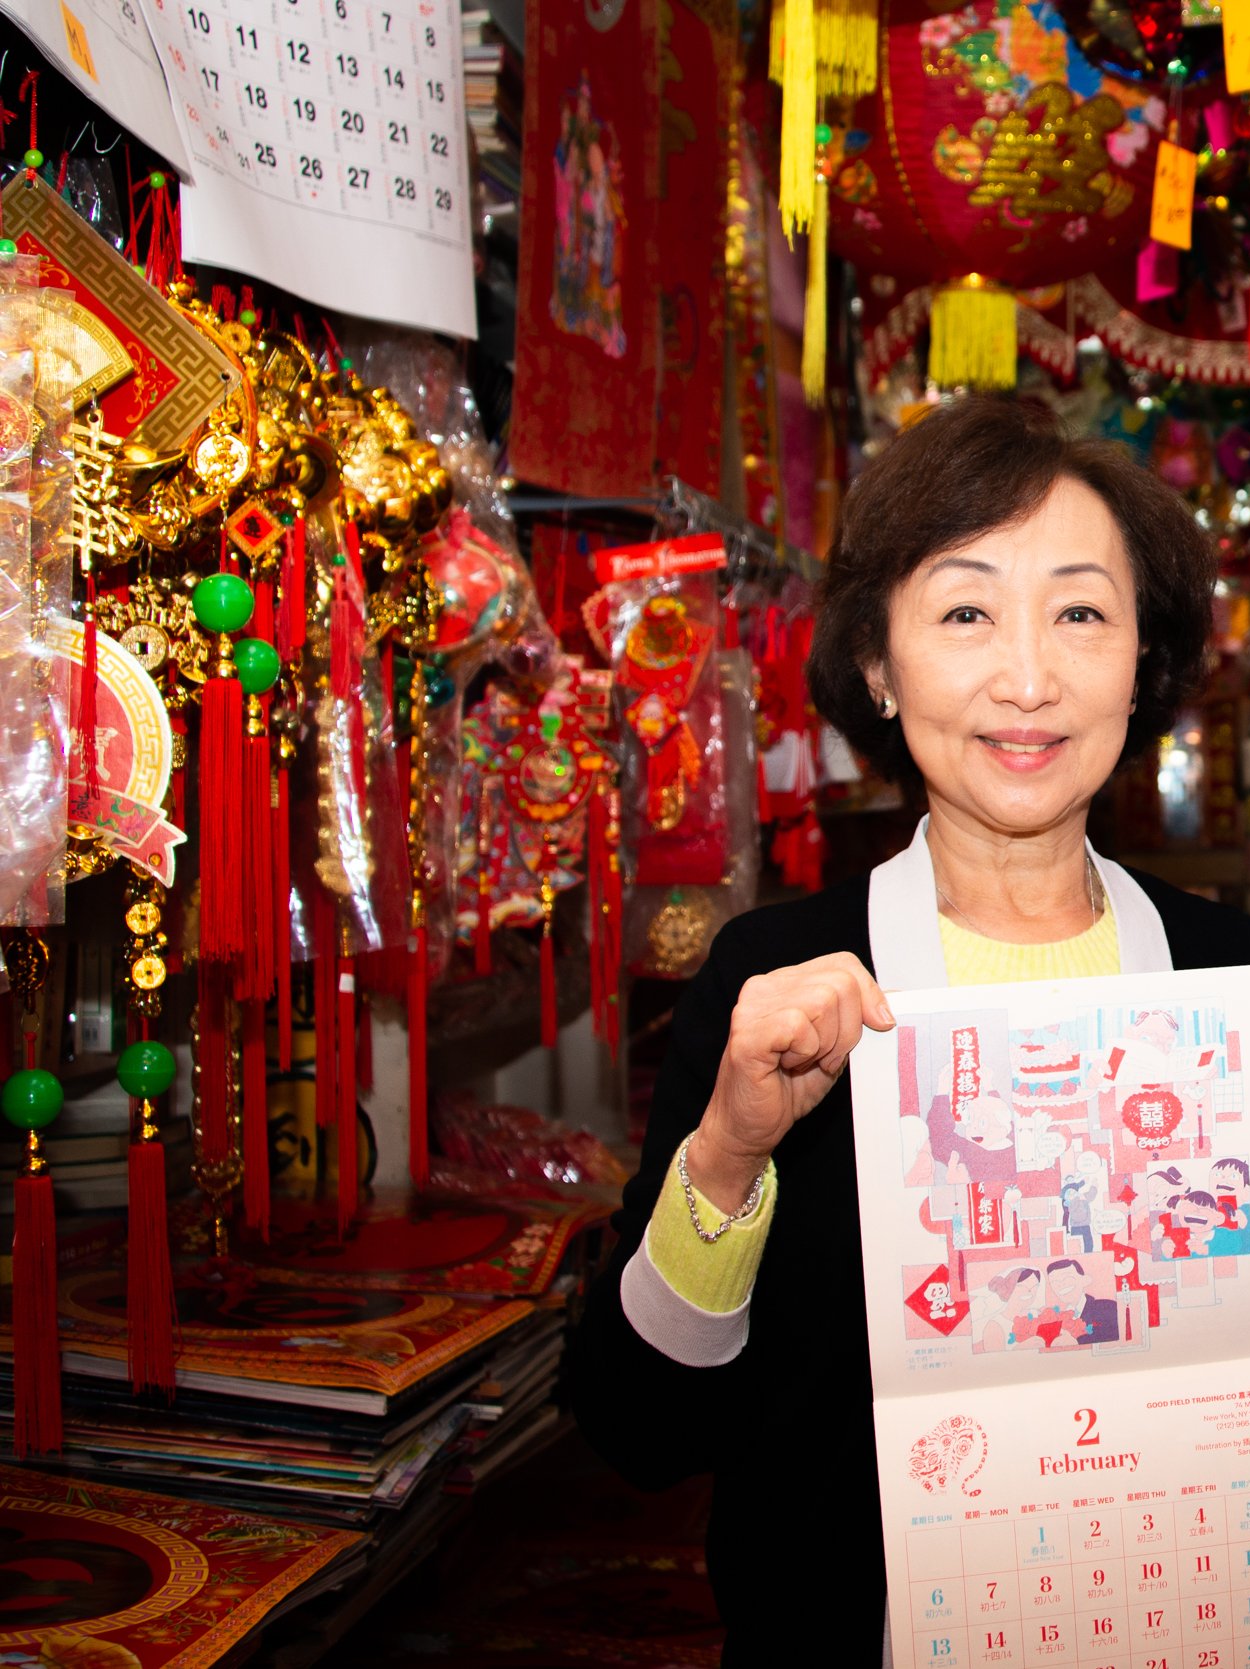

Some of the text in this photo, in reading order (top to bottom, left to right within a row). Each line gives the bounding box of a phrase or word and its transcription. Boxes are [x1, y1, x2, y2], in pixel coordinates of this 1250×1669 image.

[336, 0, 435, 47] 6 7 8
[188, 8, 444, 103] 10 11 12 13 14 15
[202, 68, 218, 92] 17
[245, 84, 267, 109] 18
[294, 98, 316, 121] 19
[342, 109, 363, 133] 20
[389, 122, 408, 144] 21
[431, 133, 448, 157] 22
[255, 142, 276, 167] 25
[300, 156, 323, 179] 26
[348, 166, 369, 188] 27
[395, 177, 415, 200] 28
[435, 188, 452, 210] 29
[1146, 1401, 1168, 1409] GOOD
[1192, 1395, 1225, 1404] TRADING
[1220, 1412, 1237, 1420] York,
[1074, 1408, 1100, 1446] 2
[1216, 1421, 1234, 1430] (212)
[1195, 1442, 1231, 1451] Illustration
[1039, 1452, 1141, 1476] February
[1127, 1492, 1149, 1501] 星期四
[1181, 1486, 1204, 1495] 星期五
[1021, 1504, 1043, 1514] 星期二
[1073, 1498, 1095, 1508] 星期三
[912, 1516, 934, 1525] 星期日
[965, 1511, 988, 1520] 星期一
[1143, 1514, 1154, 1530] 3
[1194, 1508, 1206, 1524] 4
[1038, 1527, 1045, 1543] 1
[1090, 1520, 1102, 1537] 2
[1189, 1526, 1214, 1536] 立春/4
[1084, 1539, 1110, 1550] 初二/2
[1137, 1533, 1162, 1544] 初三/3
[1140, 1562, 1162, 1580] 10
[1195, 1556, 1211, 1573] 11
[1040, 1576, 1052, 1593] 8
[1093, 1569, 1105, 1586] 9
[986, 1582, 998, 1599] 7
[1138, 1581, 1167, 1592] 初十/10
[932, 1588, 944, 1606] 6
[1034, 1594, 1061, 1605] 初八/8
[980, 1601, 1007, 1612] 初七/7
[1196, 1603, 1216, 1620] 18
[1092, 1618, 1113, 1635] 16
[1146, 1610, 1164, 1628] 17
[1193, 1621, 1222, 1632] 十八/18
[985, 1632, 1007, 1649] 14
[1040, 1625, 1059, 1642] 15
[1089, 1636, 1118, 1647] 十六/16
[1142, 1629, 1170, 1640] 十七/17
[931, 1638, 951, 1656] 13
[1036, 1644, 1065, 1655] 十五/15
[982, 1651, 1012, 1662] 十四/14
[1198, 1650, 1219, 1668] 25
